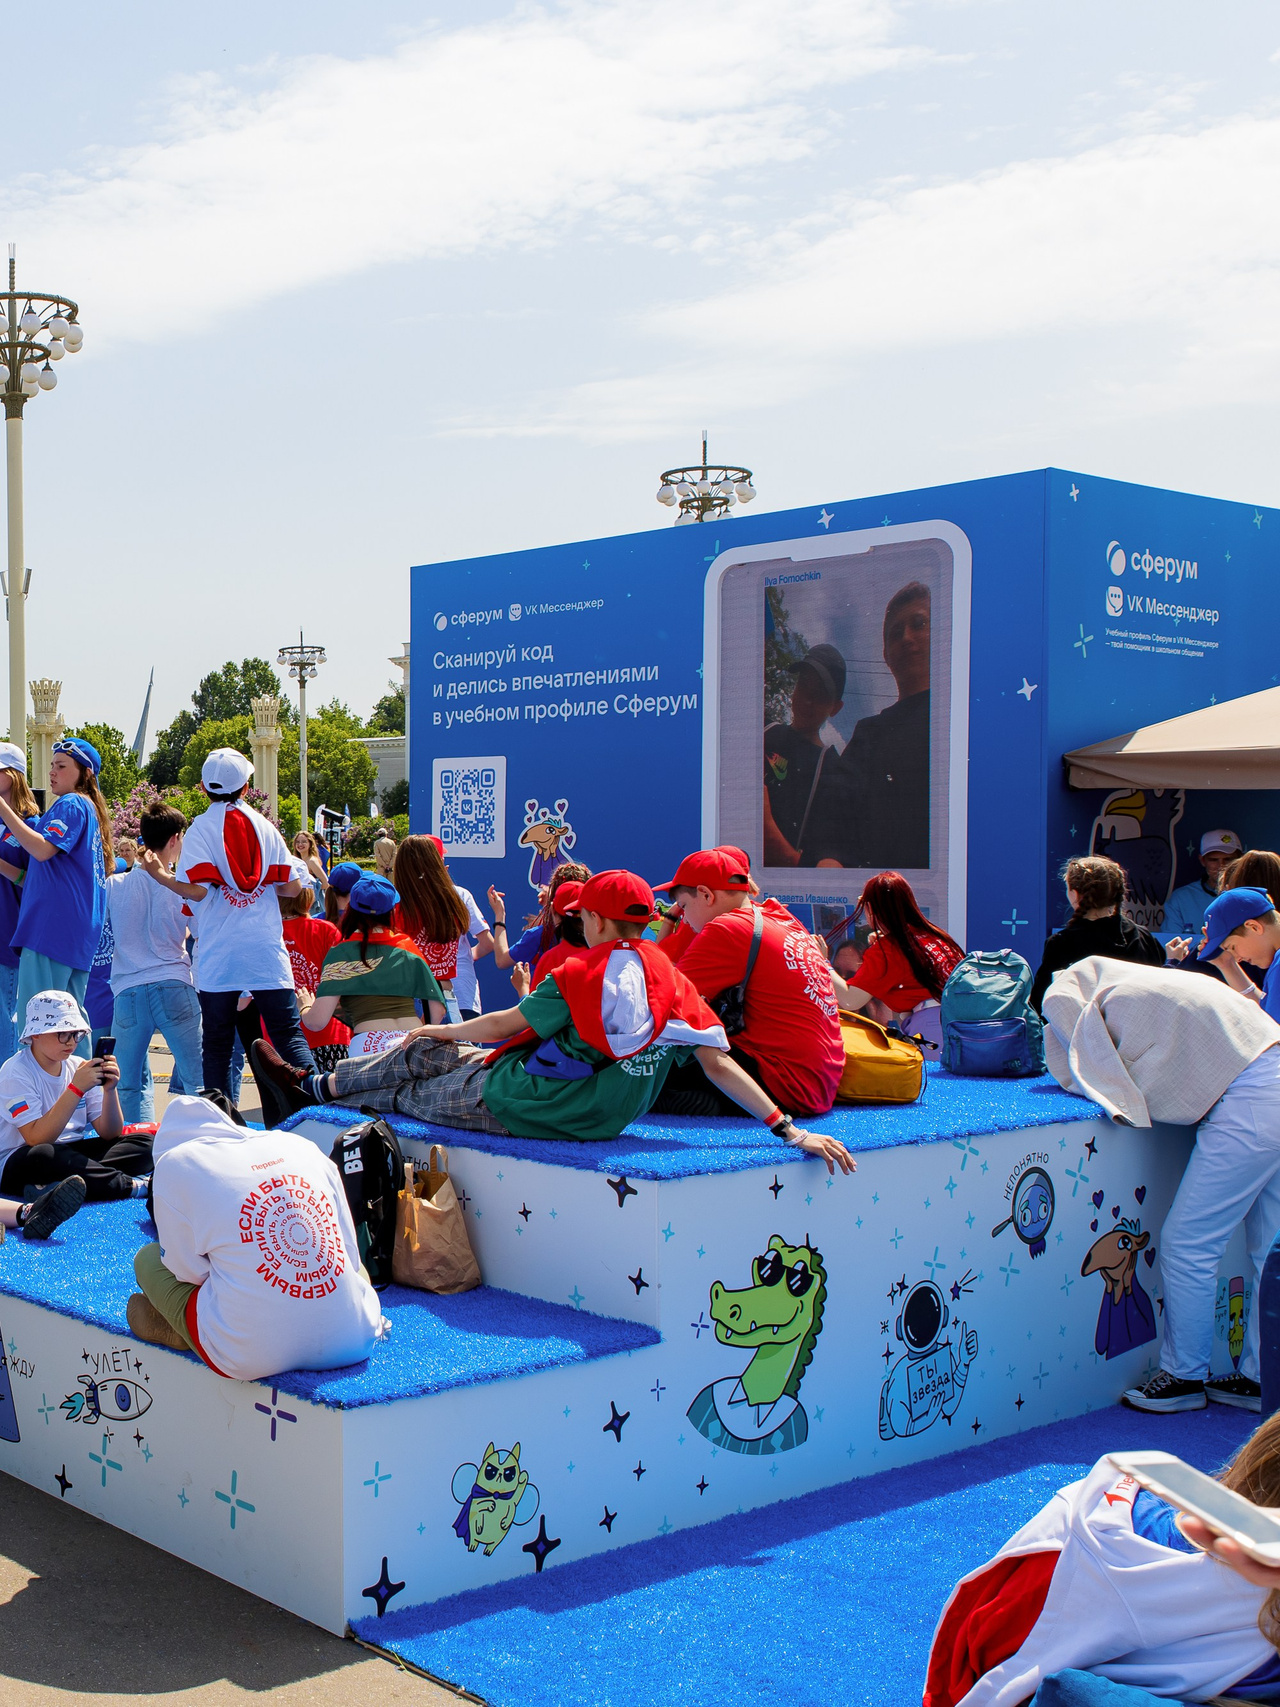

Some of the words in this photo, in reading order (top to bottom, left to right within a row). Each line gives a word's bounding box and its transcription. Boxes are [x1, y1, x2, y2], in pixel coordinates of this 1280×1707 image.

[1131, 548, 1198, 584] сферум
[451, 608, 503, 627] сферум
[525, 605, 538, 615] VK
[540, 598, 604, 615] Мессенджер
[1127, 594, 1143, 613] VK
[1146, 597, 1220, 626] Мессенджер
[433, 644, 516, 670] Сканируй
[521, 644, 554, 663] код
[433, 683, 443, 698] и
[447, 677, 508, 700] делись
[512, 665, 659, 692] впечатлениями
[433, 711, 442, 726] в
[445, 703, 519, 729] учебном
[524, 698, 608, 724] профиле
[613, 694, 698, 718] Сферум
[805, 893, 848, 904] Иващенко
[783, 931, 798, 970] ЕСЛИ
[804, 985, 837, 1016] ЕРВЫМ
[620, 1059, 654, 1076] ПЕРВ
[251, 1158, 285, 1171] Первые
[1003, 1152, 1049, 1201] НЕПОНЯТНО
[258, 1174, 315, 1195] БЫТЬ,
[286, 1188, 305, 1199] ТО
[239, 1191, 261, 1243] ЕСЛИ
[255, 1195, 286, 1228] БЫТЬ,
[273, 1206, 285, 1217] ТО
[286, 1202, 313, 1215] БЫТЬ
[307, 1195, 331, 1236] БЫТЬ
[320, 1190, 334, 1217] ТО
[255, 1231, 282, 1270] ЕСЛИ
[312, 1214, 326, 1263] ПЕРВЫМ
[332, 1223, 345, 1277] БЫТЬ
[280, 1251, 307, 1268] ЕСЛИ
[296, 1239, 335, 1282] ПЕРВЫМ
[256, 1262, 338, 1299] ПЕРВЫМ
[9, 1355, 36, 1379] ЖДУ
[90, 1346, 131, 1375] УЛЁТ
[912, 1372, 951, 1404] звезда
